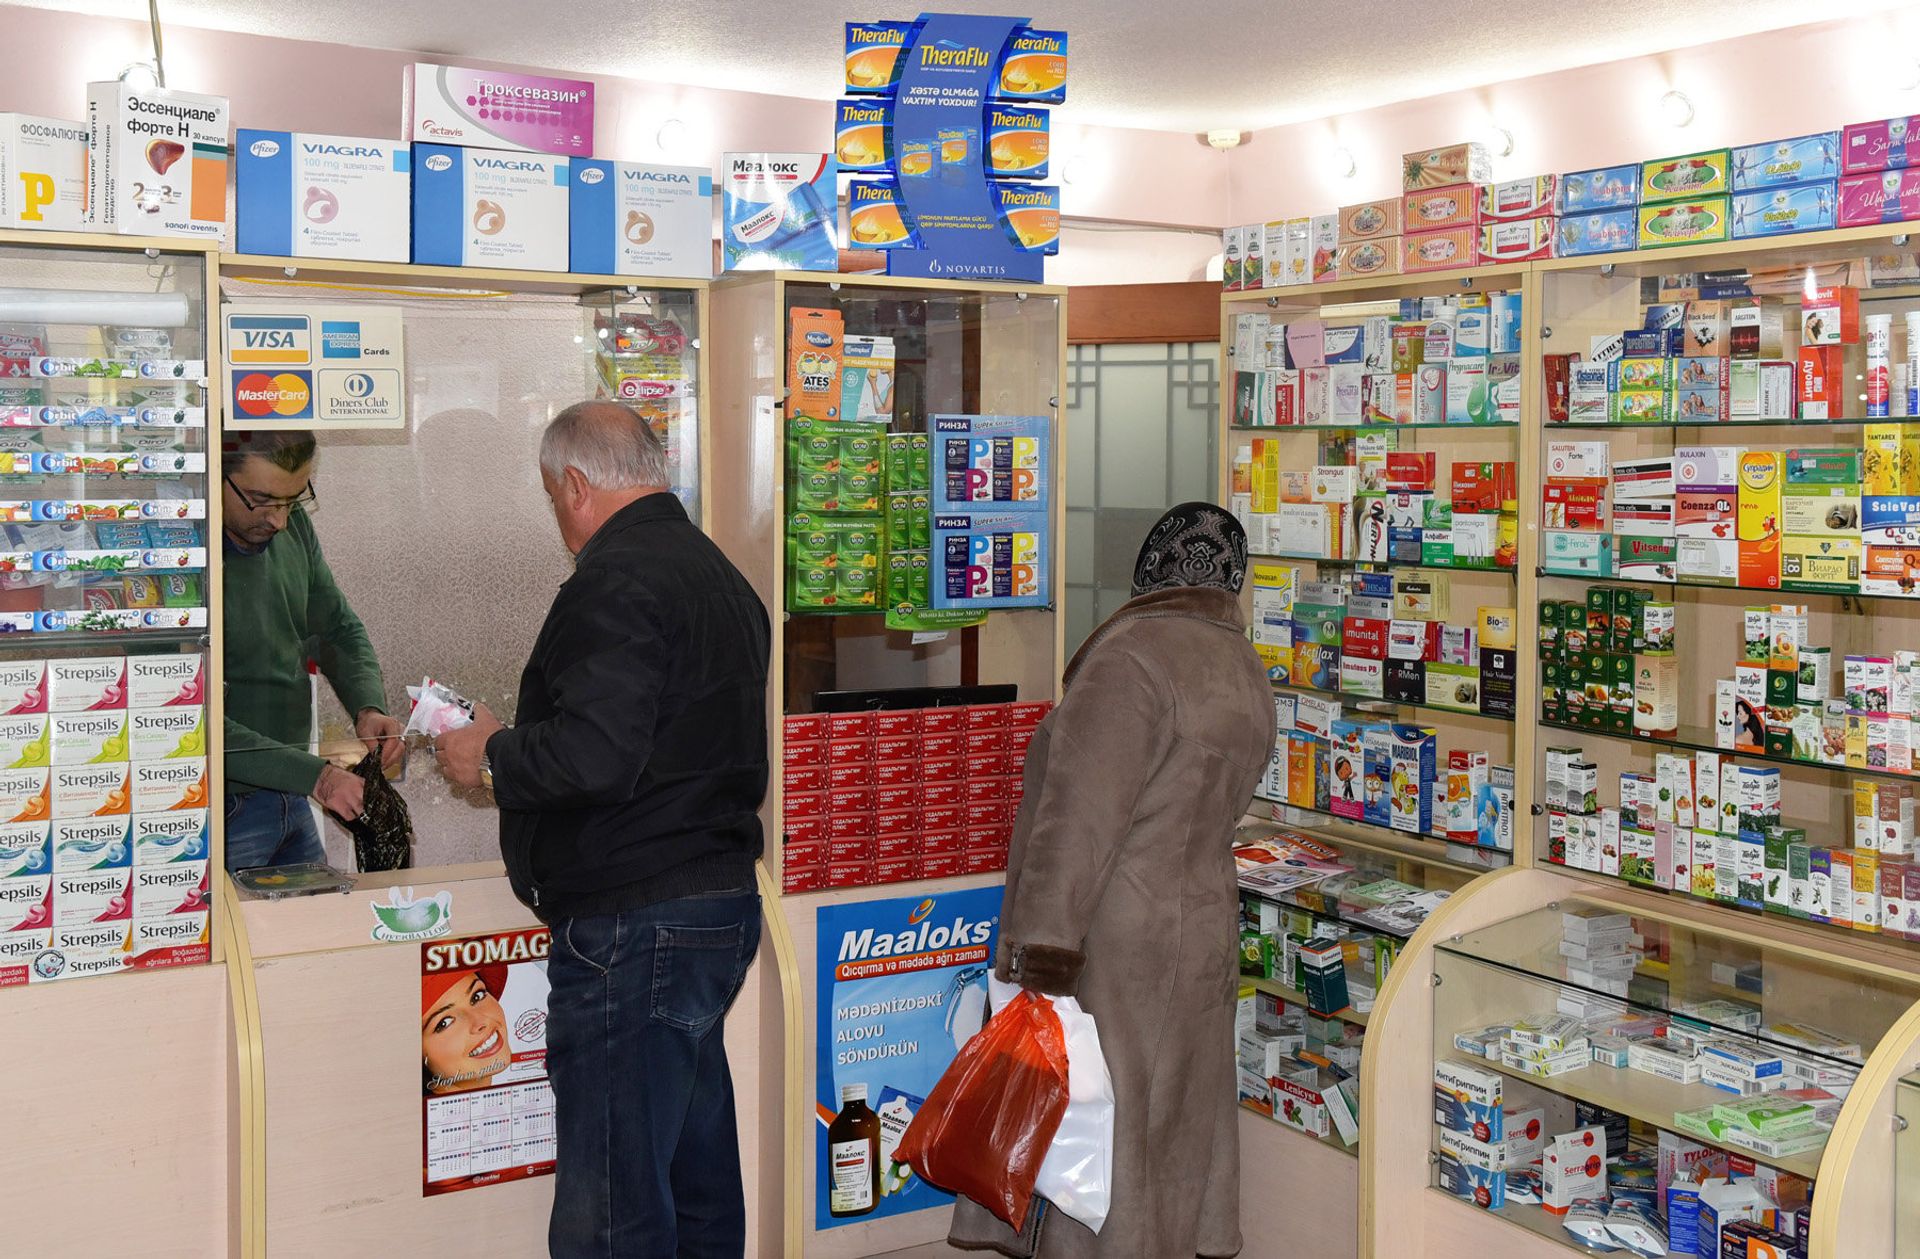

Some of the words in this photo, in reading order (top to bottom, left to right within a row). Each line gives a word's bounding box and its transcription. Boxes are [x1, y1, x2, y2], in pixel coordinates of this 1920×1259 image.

[851, 28, 905, 43] TheraFlu
[920, 45, 989, 66] TheraFlu
[910, 87, 940, 96] XƏSTƏ
[902, 97, 936, 106] VAXTIM
[938, 98, 977, 107] YOXDUR!
[843, 107, 884, 122] TheraF
[992, 112, 1043, 128] TheraFlu
[21, 124, 86, 142] ФОСФАЛЮГЕ
[127, 118, 174, 136] форте
[178, 122, 189, 137] Н
[429, 123, 463, 137] actavis
[202, 135, 225, 143] капсул
[253, 144, 278, 157] Pfizer
[303, 143, 382, 158] VIAGRA
[304, 158, 321, 167] 100
[323, 160, 339, 170] mg
[427, 157, 451, 170] Pfizer
[473, 158, 545, 172] VIAGRA
[474, 172, 491, 182] 100
[492, 175, 506, 184] mg
[582, 168, 605, 181] Pfizer
[624, 170, 690, 183] VIAGRA
[625, 184, 641, 193] 100
[641, 186, 655, 196] mg
[857, 186, 893, 201] Thera
[1001, 190, 1051, 205] TheraFlu
[165, 221, 189, 230] sanofi
[191, 223, 218, 232] aventis
[741, 211, 775, 233] Маалокс
[946, 265, 1005, 274] NOVARTIS
[243, 331, 295, 348] VISA
[364, 348, 390, 356] Cards
[40, 358, 77, 376] Orbit
[1449, 360, 1484, 374] Pregnacare
[238, 389, 307, 401] MasterCard
[330, 397, 362, 408] Diners
[365, 398, 389, 408] Club
[39, 407, 77, 424] Orbit
[939, 422, 968, 430] РИНЗА
[41, 455, 79, 471] Orbit
[1317, 468, 1344, 477] Strongus
[42, 502, 79, 519] Orbit
[939, 519, 967, 527] РИНЗА
[1632, 540, 1670, 556] Vitseng
[43, 555, 80, 571] Orbit
[43, 613, 80, 629] Orbit
[1346, 628, 1378, 640] imunital
[55, 667, 117, 682] Strepsils
[134, 662, 194, 679] Strepsils
[57, 718, 119, 736] Strepsils
[135, 714, 195, 732] Strepsils
[59, 771, 121, 788] Strepsils
[139, 765, 198, 783] Strepsils
[60, 824, 122, 842] Strepsils
[140, 818, 199, 835] Strepsils
[140, 869, 199, 886] Strepsils
[60, 878, 122, 895] Strepsils
[140, 922, 200, 939] Strepsils
[60, 931, 122, 948] Strepsils
[426, 933, 553, 971] STOMAG
[886, 961, 896, 971] və
[899, 955, 934, 969] mədədə
[936, 953, 953, 967] ağrı
[955, 949, 986, 962] zamanı
[70, 956, 121, 973] Strepsils
[837, 990, 943, 1021] MƏDƏNİZDƏKİ
[837, 1024, 885, 1043] ALOVU
[837, 1039, 919, 1065] SÖNDÜRÜN
[1436, 1069, 1488, 1095] АнтиГриппин
[1441, 1132, 1490, 1160] АнтиГриппин
[836, 1150, 866, 1160] Маалокс
